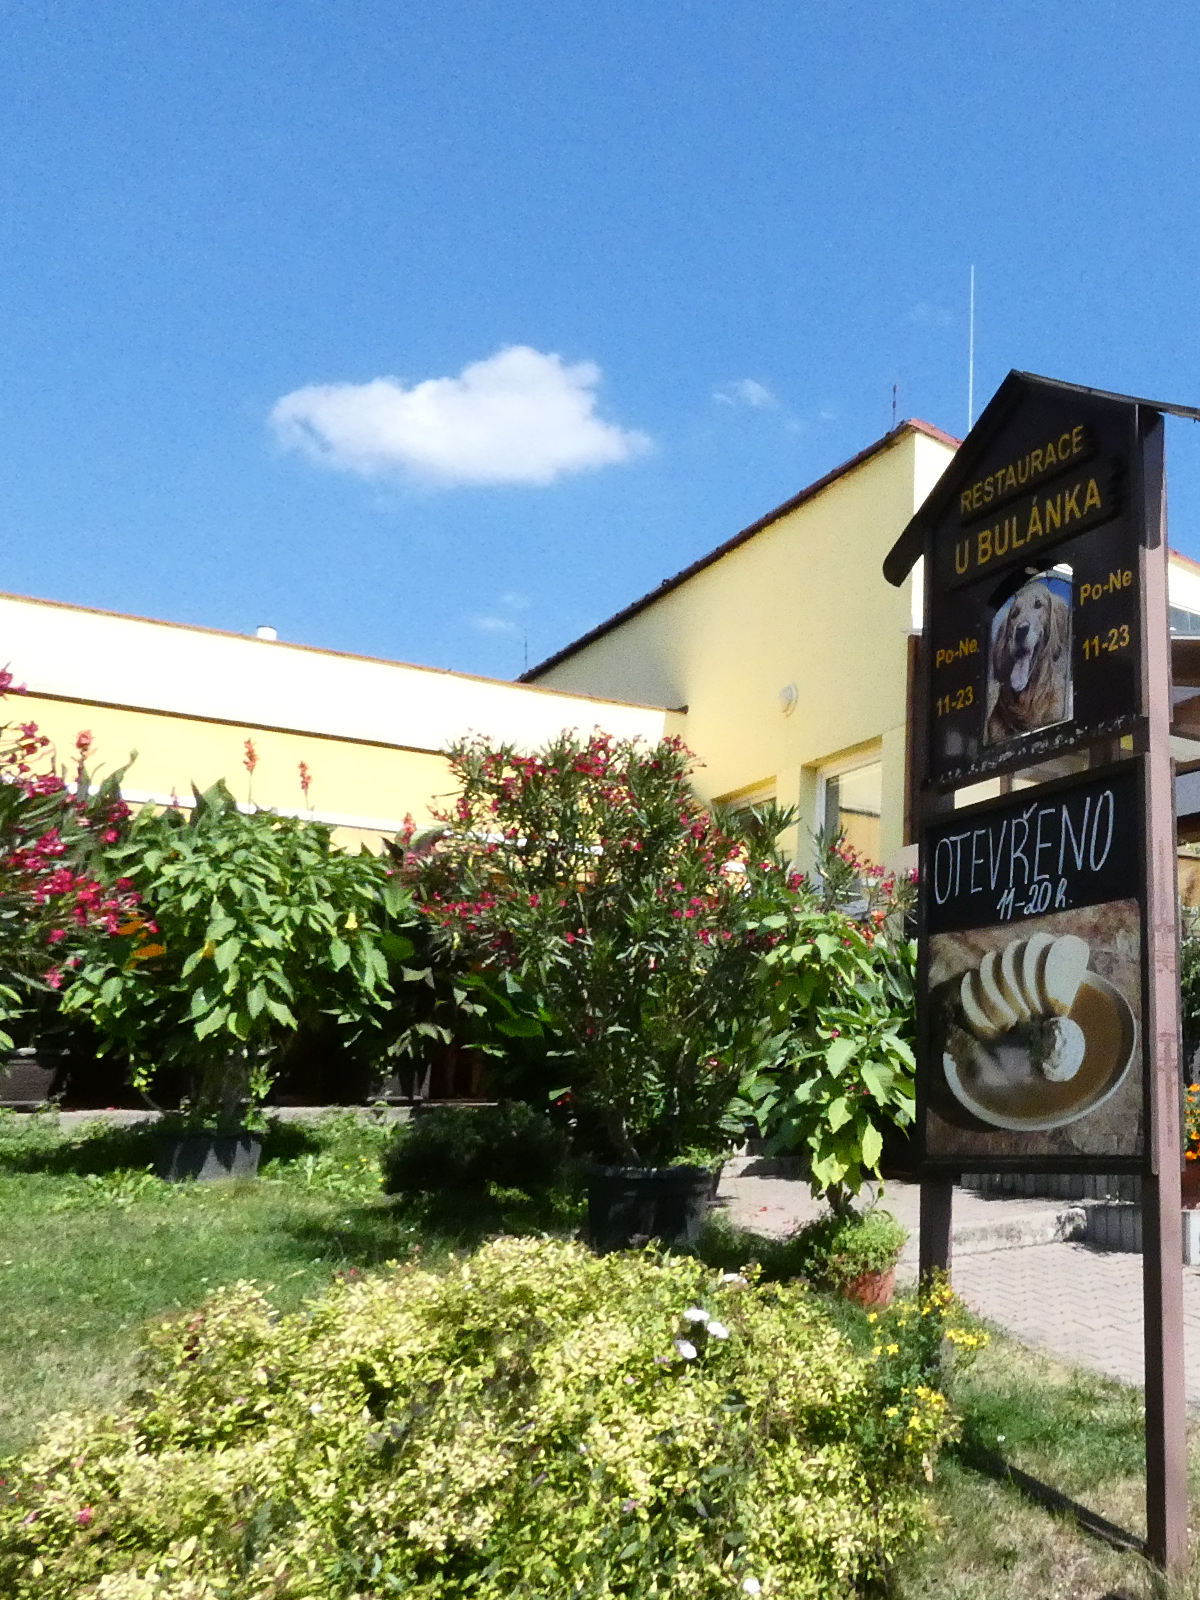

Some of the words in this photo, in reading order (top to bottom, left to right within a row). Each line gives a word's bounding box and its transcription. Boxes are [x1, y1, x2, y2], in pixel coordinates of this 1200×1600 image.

[961, 425, 1084, 513] RESTAURACE
[955, 539, 969, 575] U
[977, 478, 1102, 566] BULÁNKA
[1079, 569, 1133, 607] Po-Ne
[935, 638, 978, 669] Po-Ne
[1083, 624, 1130, 660] 11-23
[936, 686, 974, 716] 11-23
[934, 790, 1115, 906] OTEVŘENO
[996, 881, 1052, 920] 11-20
